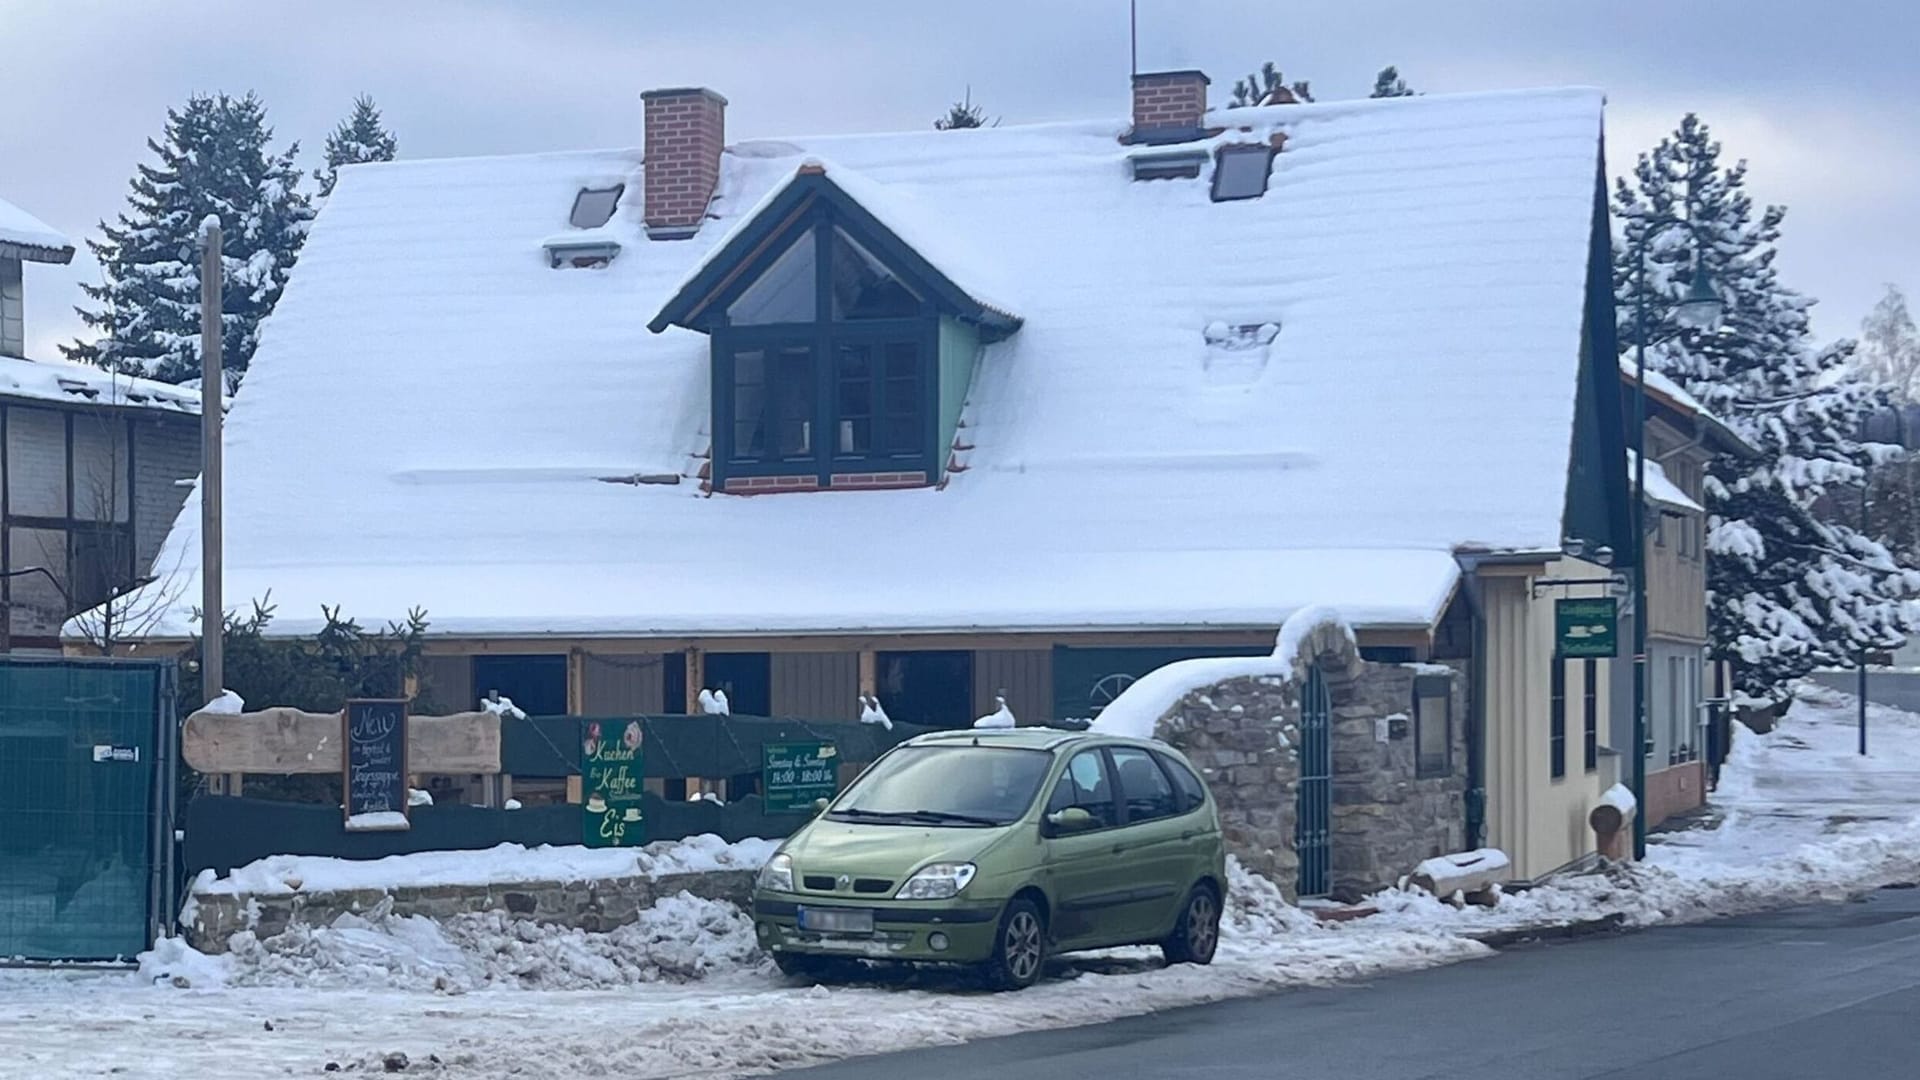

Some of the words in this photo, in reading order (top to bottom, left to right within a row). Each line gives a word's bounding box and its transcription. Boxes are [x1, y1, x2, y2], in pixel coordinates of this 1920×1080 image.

[590, 740, 635, 762] Kuchen
[595, 766, 636, 795] Kaffee
[801, 769, 823, 782] 18:00
[600, 808, 625, 837] Eis
